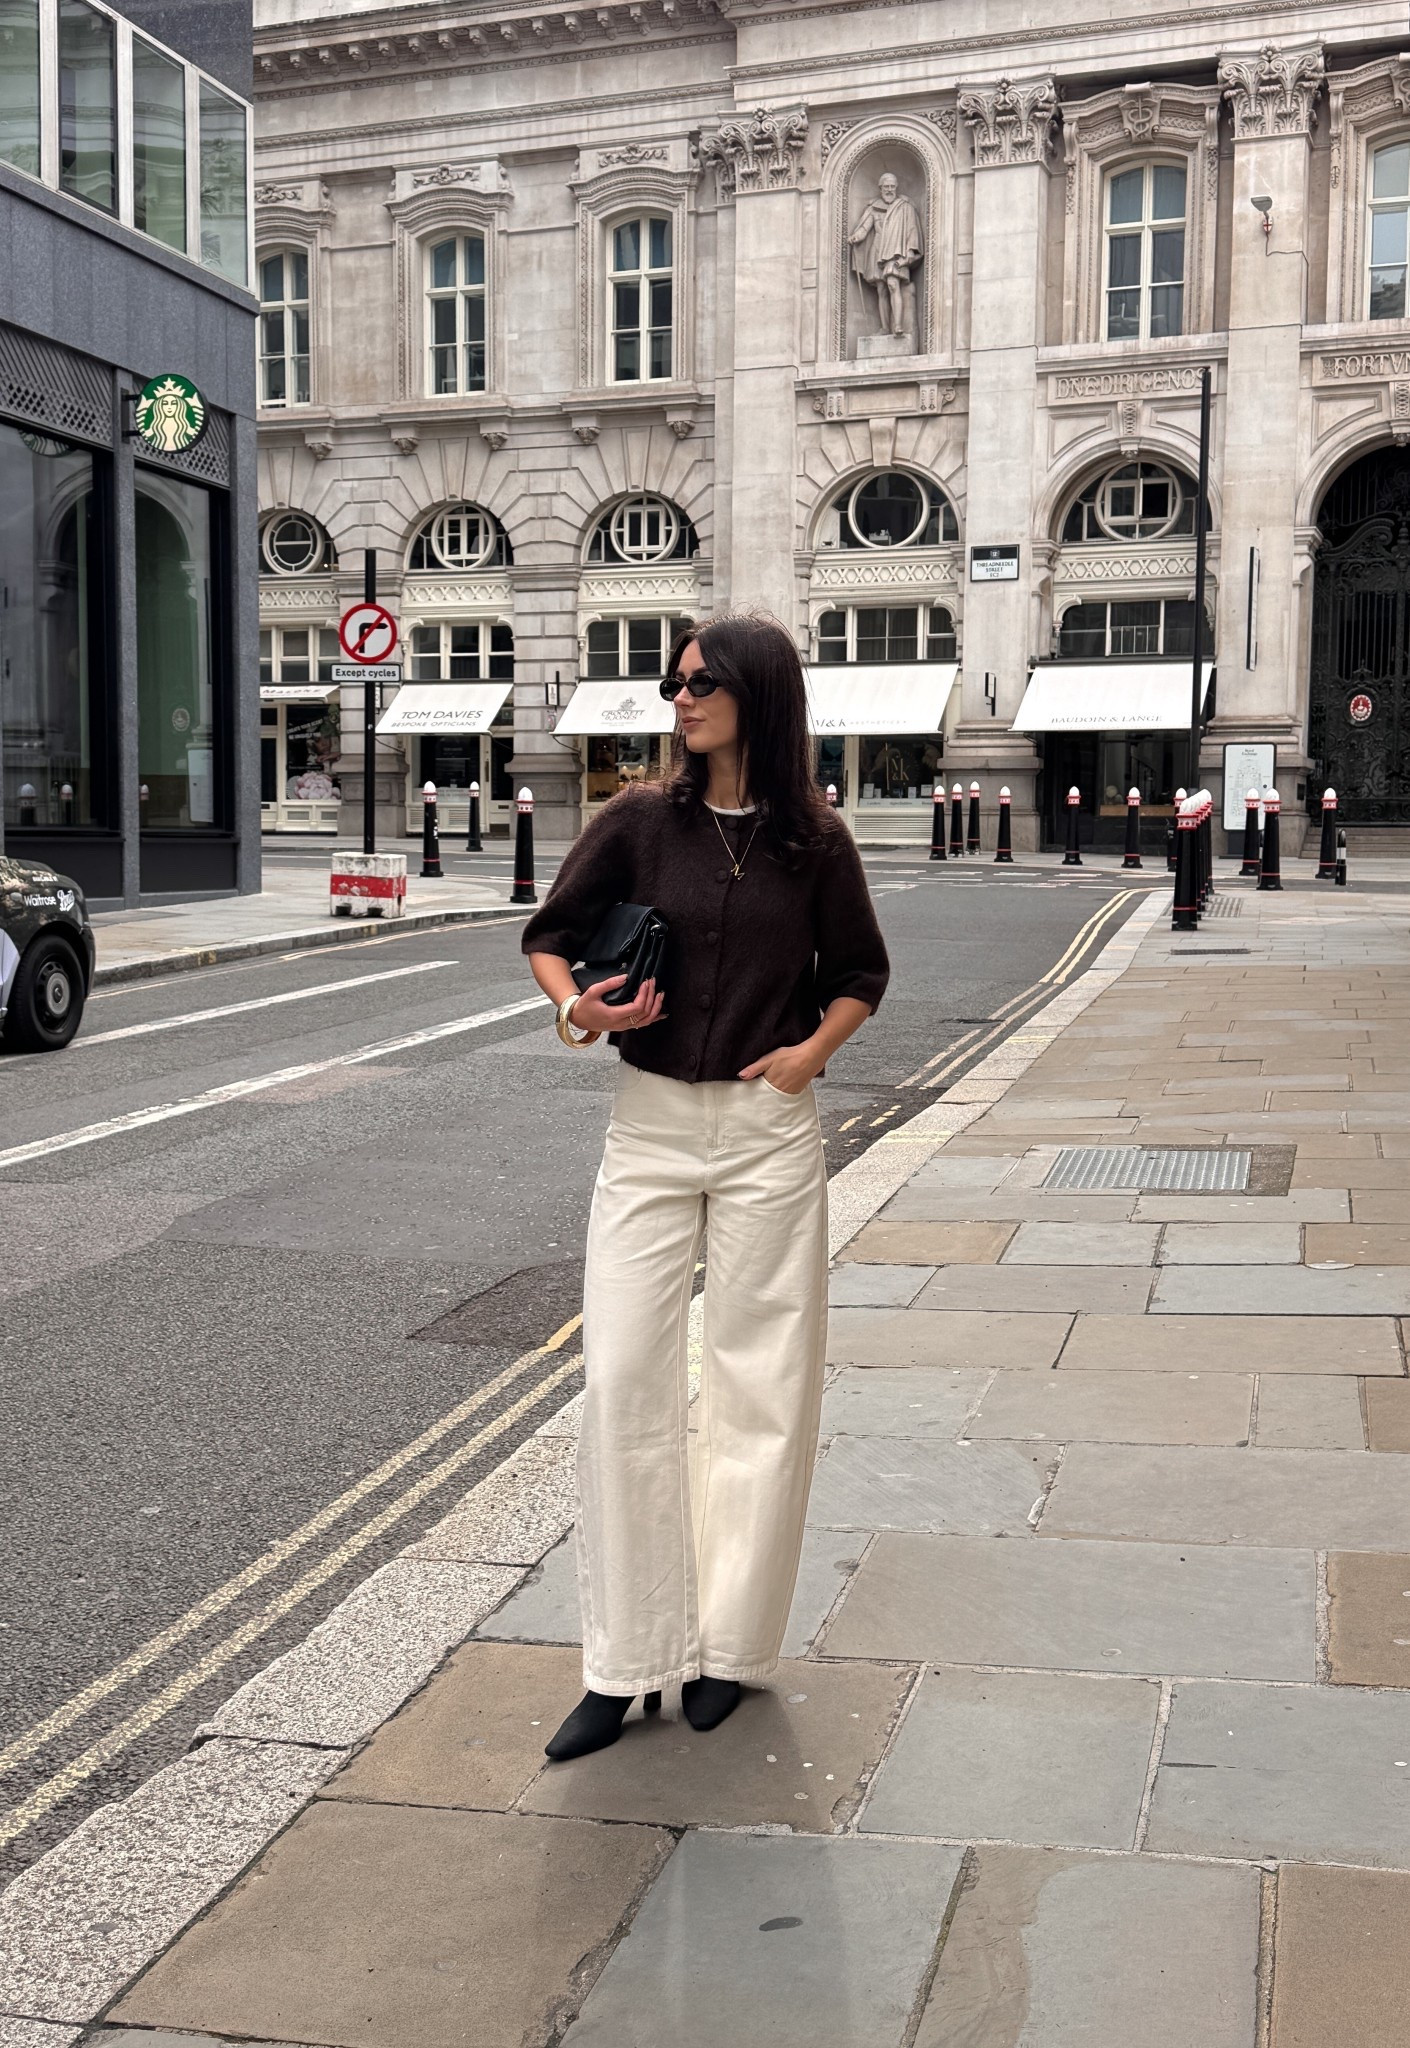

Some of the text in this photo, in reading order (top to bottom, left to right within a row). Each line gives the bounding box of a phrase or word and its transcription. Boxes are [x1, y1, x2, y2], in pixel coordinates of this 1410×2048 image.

[335, 668, 397, 679] Except cycles
[401, 710, 483, 719] TOM DAVIES
[1051, 716, 1107, 724] BAUDOIN
[1121, 715, 1163, 723] LANGE
[24, 894, 57, 907] Waitrose
